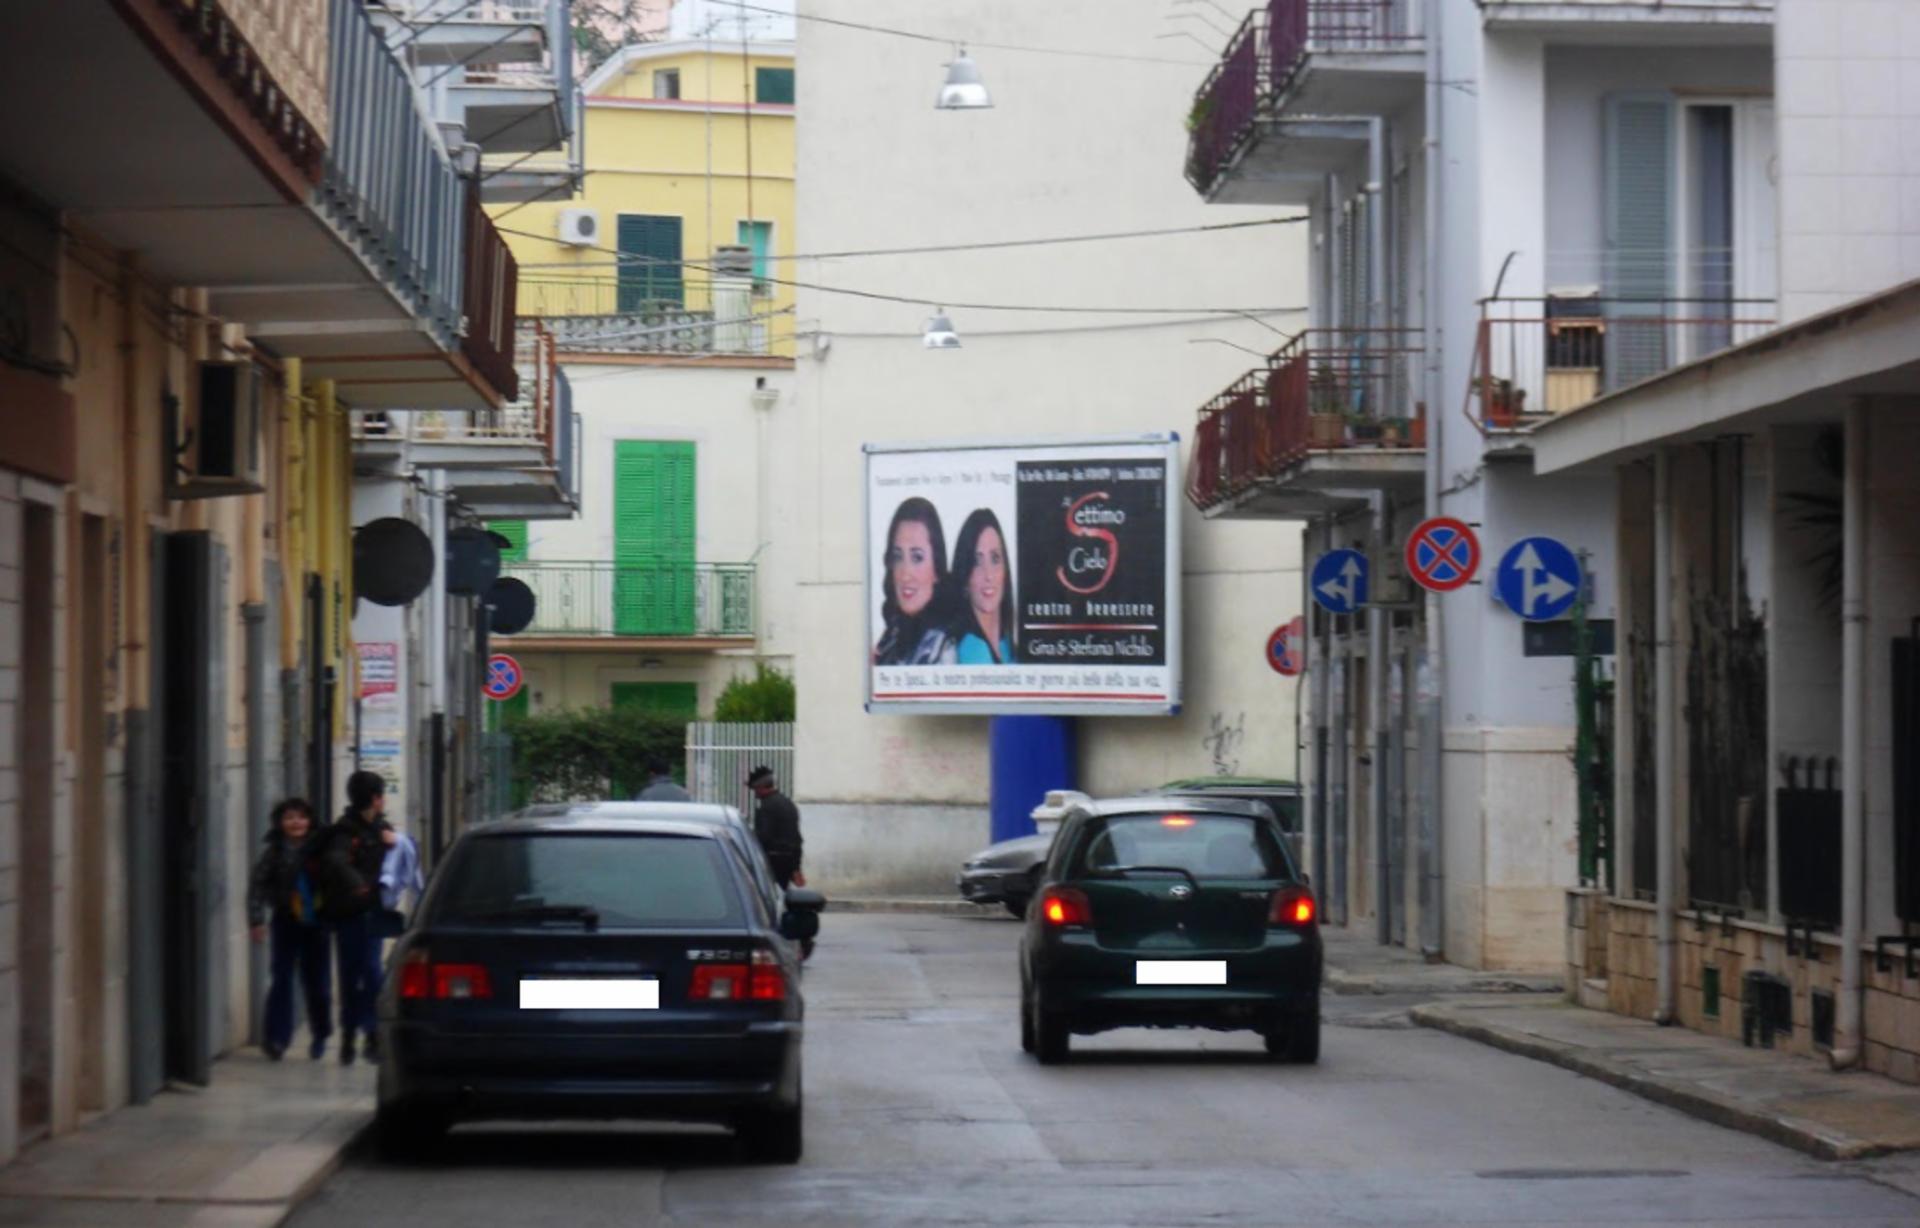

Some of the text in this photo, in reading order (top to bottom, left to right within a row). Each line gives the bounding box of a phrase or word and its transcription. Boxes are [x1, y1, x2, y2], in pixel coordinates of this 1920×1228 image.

[1068, 546, 1108, 574] Cielo
[1027, 600, 1155, 617] centro benessere
